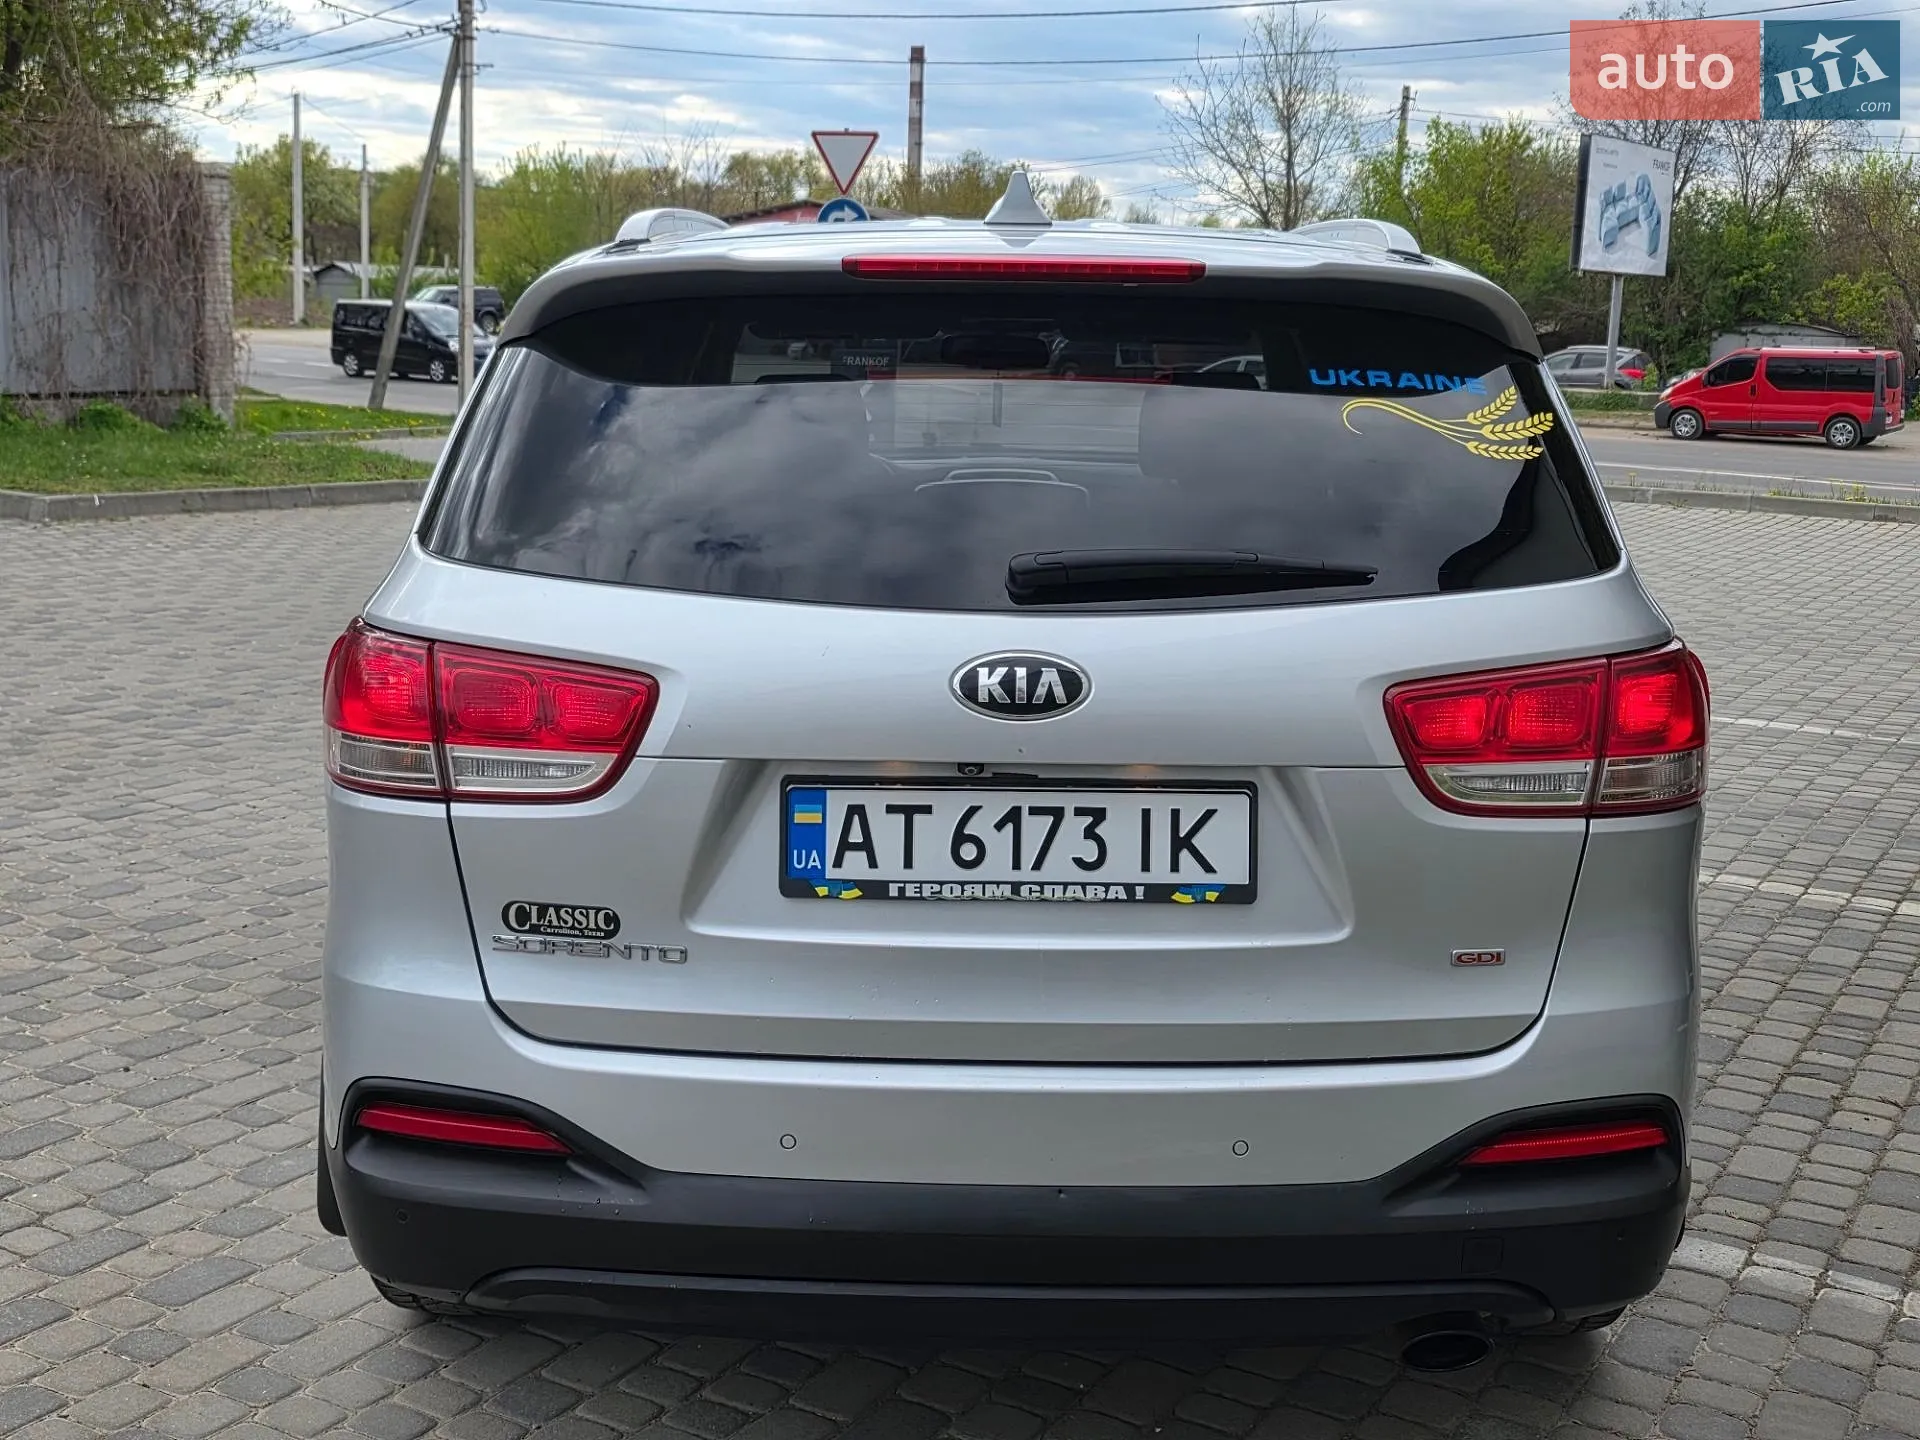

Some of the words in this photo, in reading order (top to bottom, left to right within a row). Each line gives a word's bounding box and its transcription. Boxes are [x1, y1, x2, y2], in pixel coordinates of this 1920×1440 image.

[1309, 368, 1487, 394] UKRAINE
[977, 667, 1067, 704] KIA
[832, 804, 933, 870] AT
[950, 805, 1108, 871] 6173
[1141, 808, 1218, 874] IK
[793, 849, 821, 870] UA
[888, 882, 1013, 899] ГЕРОЯМ
[508, 903, 615, 931] CLASSIC
[492, 935, 688, 964] SORENTO
[1456, 952, 1502, 963] GDI
